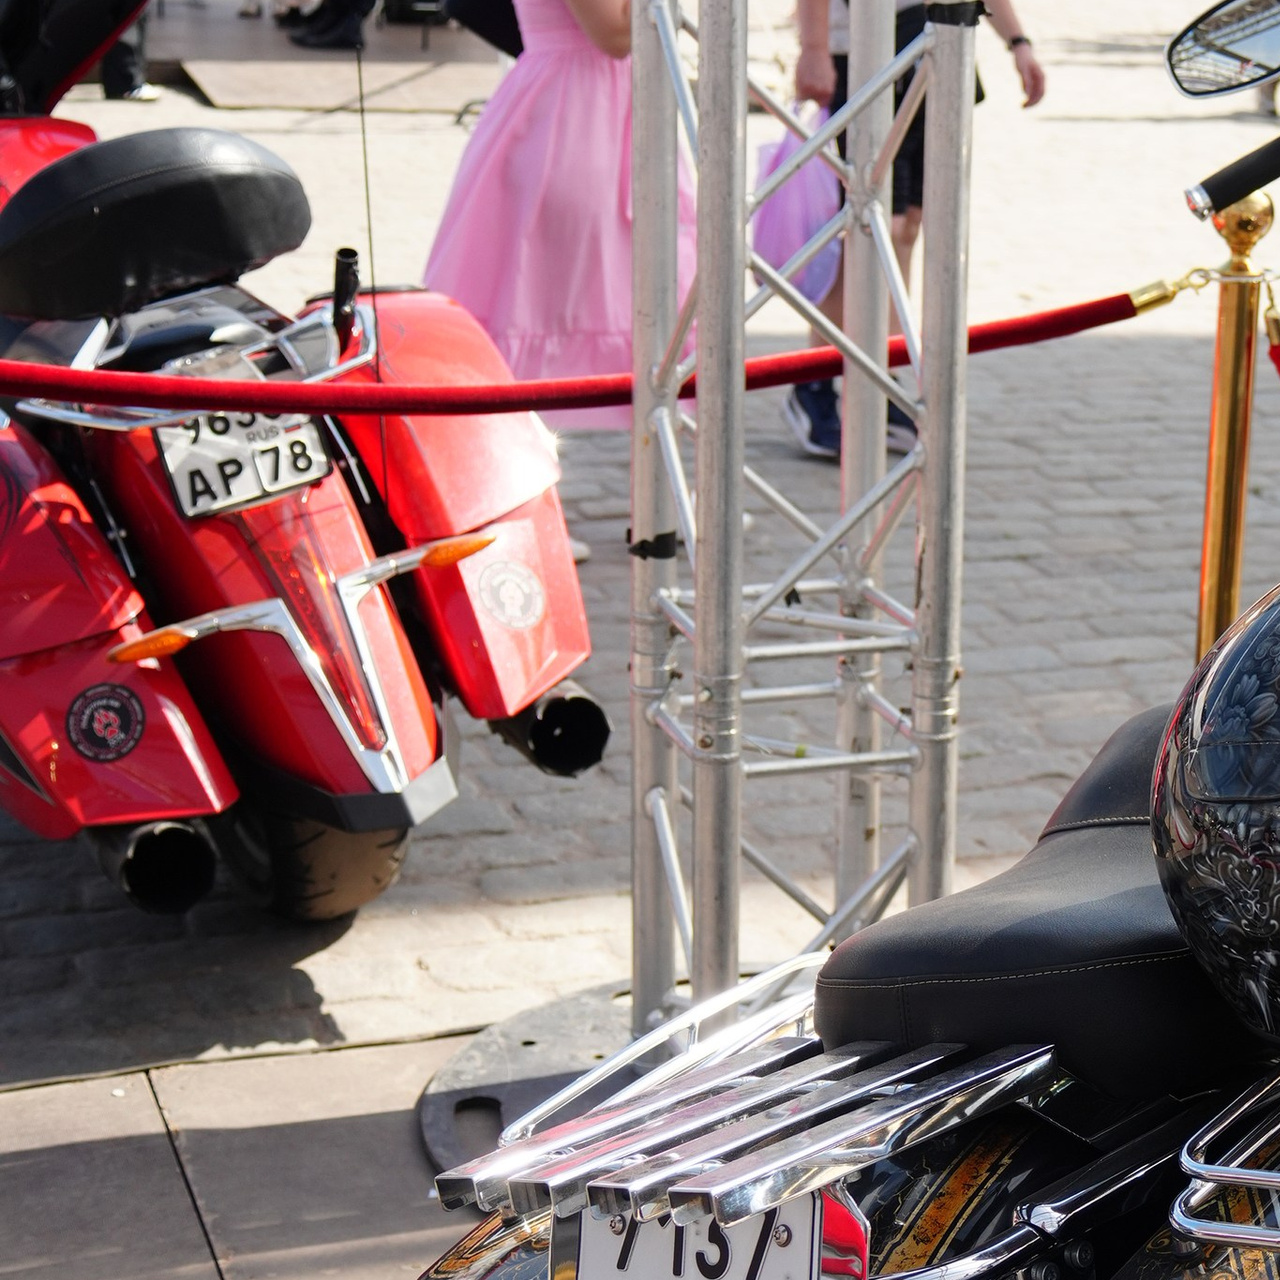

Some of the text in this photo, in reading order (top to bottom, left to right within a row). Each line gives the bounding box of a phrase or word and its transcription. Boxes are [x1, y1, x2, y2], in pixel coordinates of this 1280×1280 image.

[245, 425, 280, 443] RUS
[189, 440, 313, 507] AP 78
